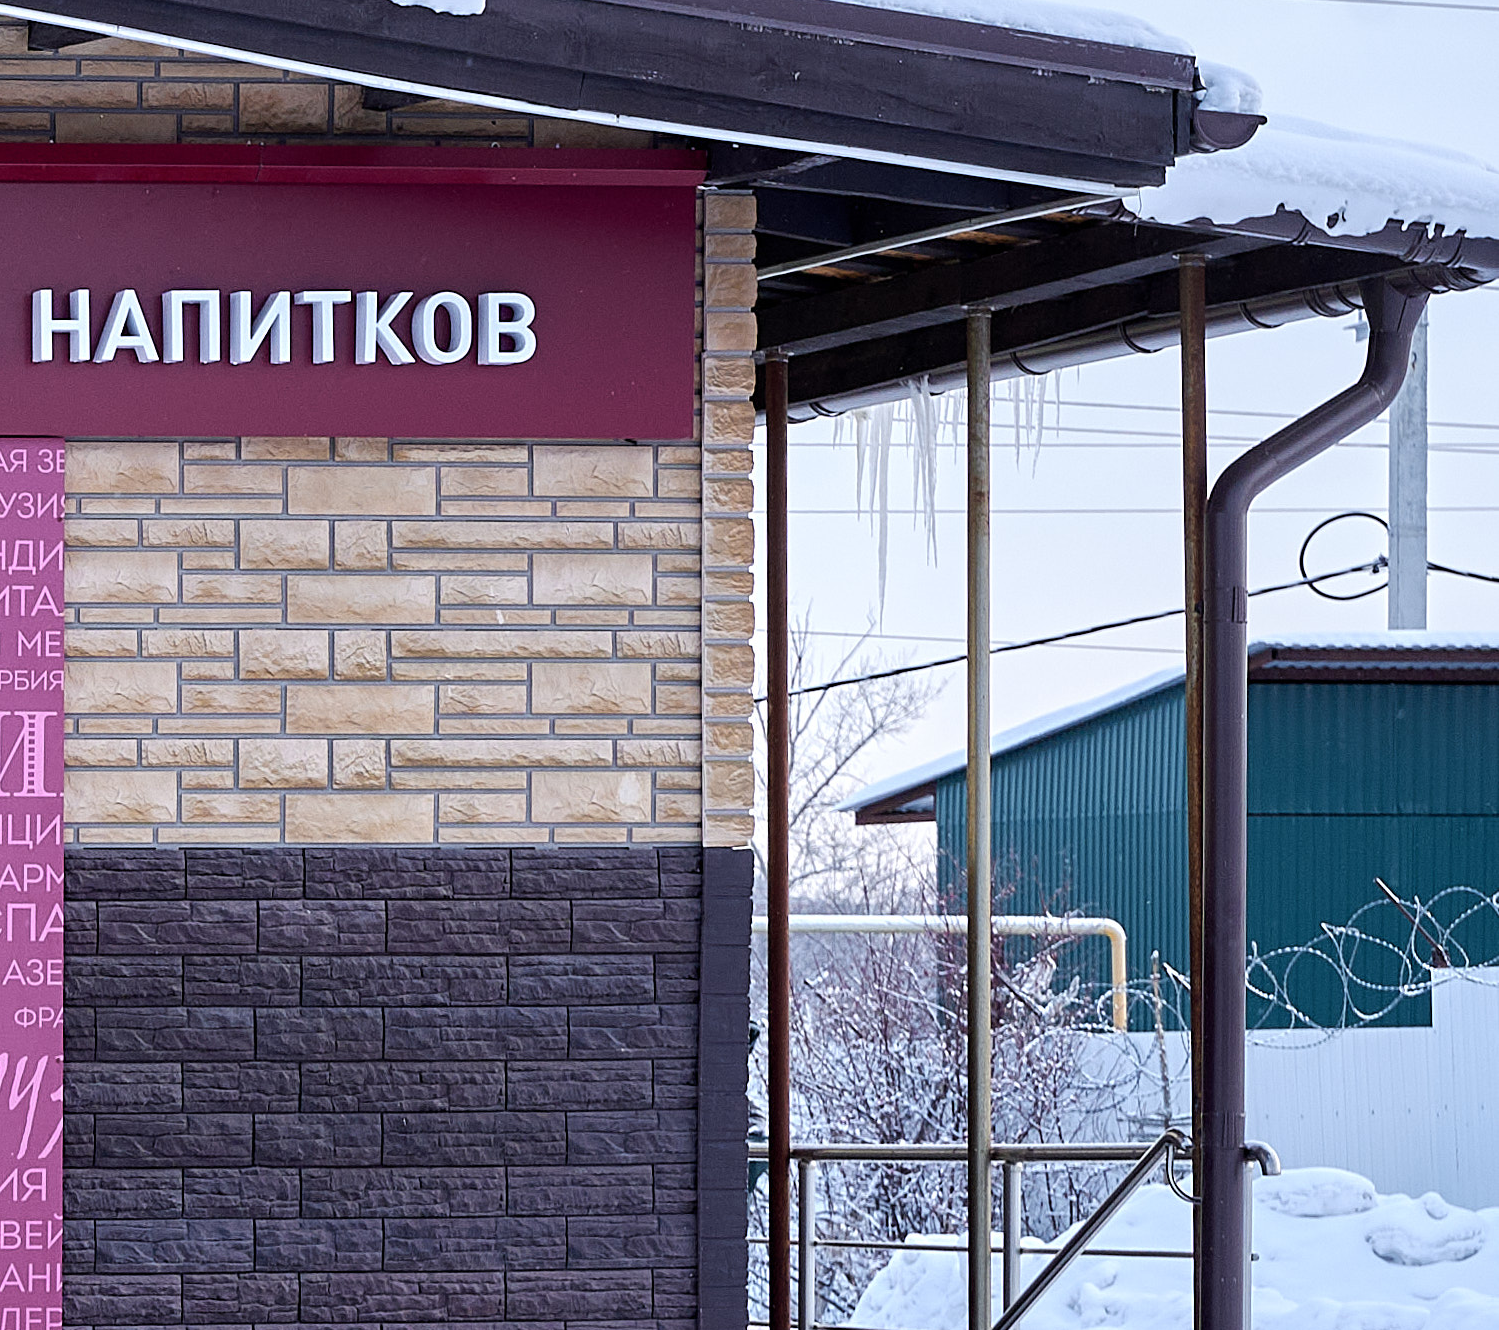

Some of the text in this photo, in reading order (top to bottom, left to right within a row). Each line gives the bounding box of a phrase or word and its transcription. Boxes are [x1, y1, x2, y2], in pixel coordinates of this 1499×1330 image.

[31, 287, 538, 366] НАПИТКОВ
[18, 630, 61, 657] МЕ
[2, 960, 62, 986] АЗЕ
